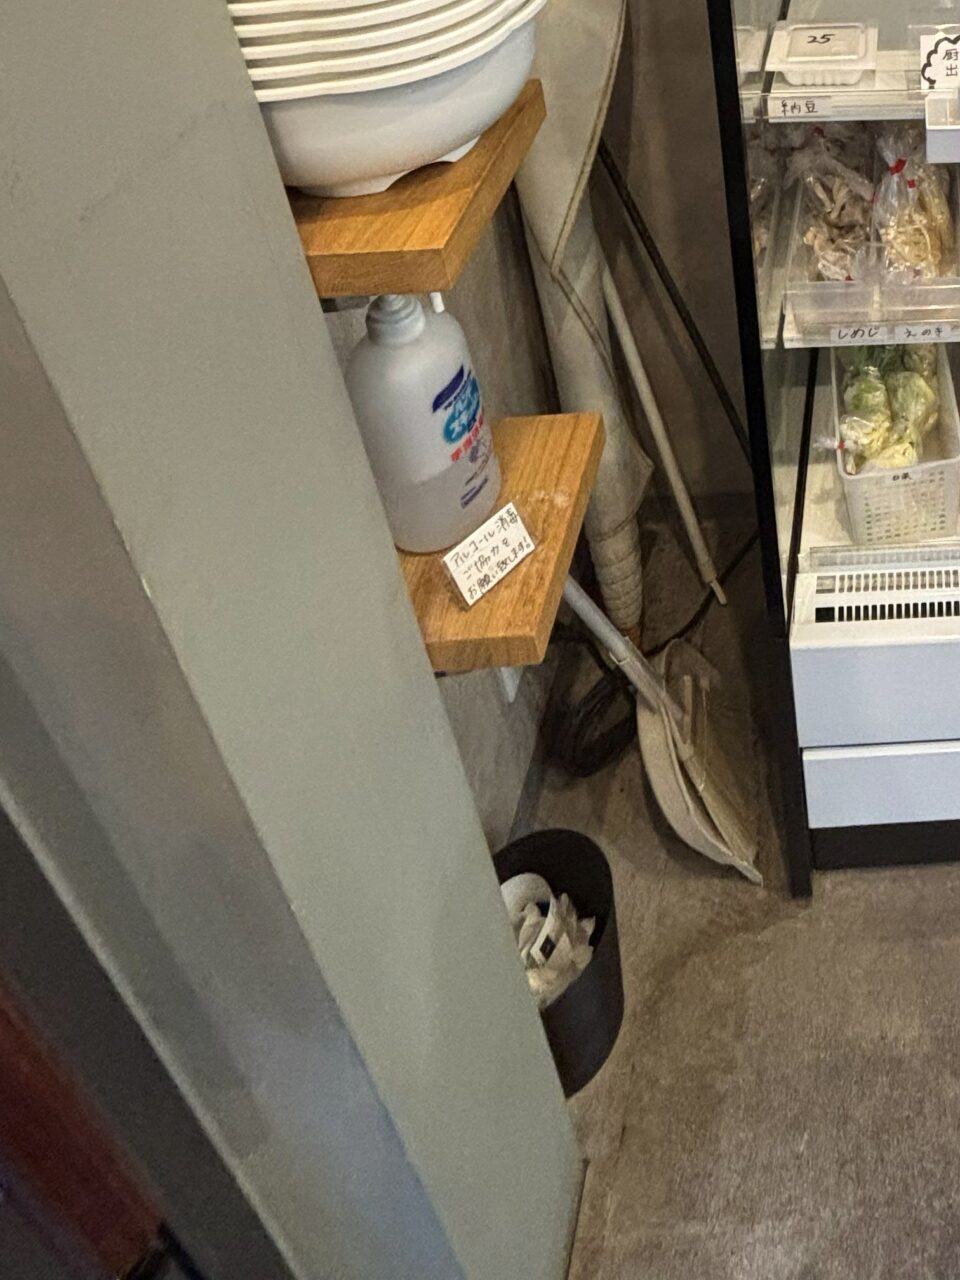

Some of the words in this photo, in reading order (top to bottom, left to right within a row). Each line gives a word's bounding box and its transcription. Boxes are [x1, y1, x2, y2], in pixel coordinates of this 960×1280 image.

[807, 32, 836, 45] 25
[781, 99, 819, 116] 納豆
[837, 326, 881, 340] しめじ
[905, 327, 944, 338] えのき
